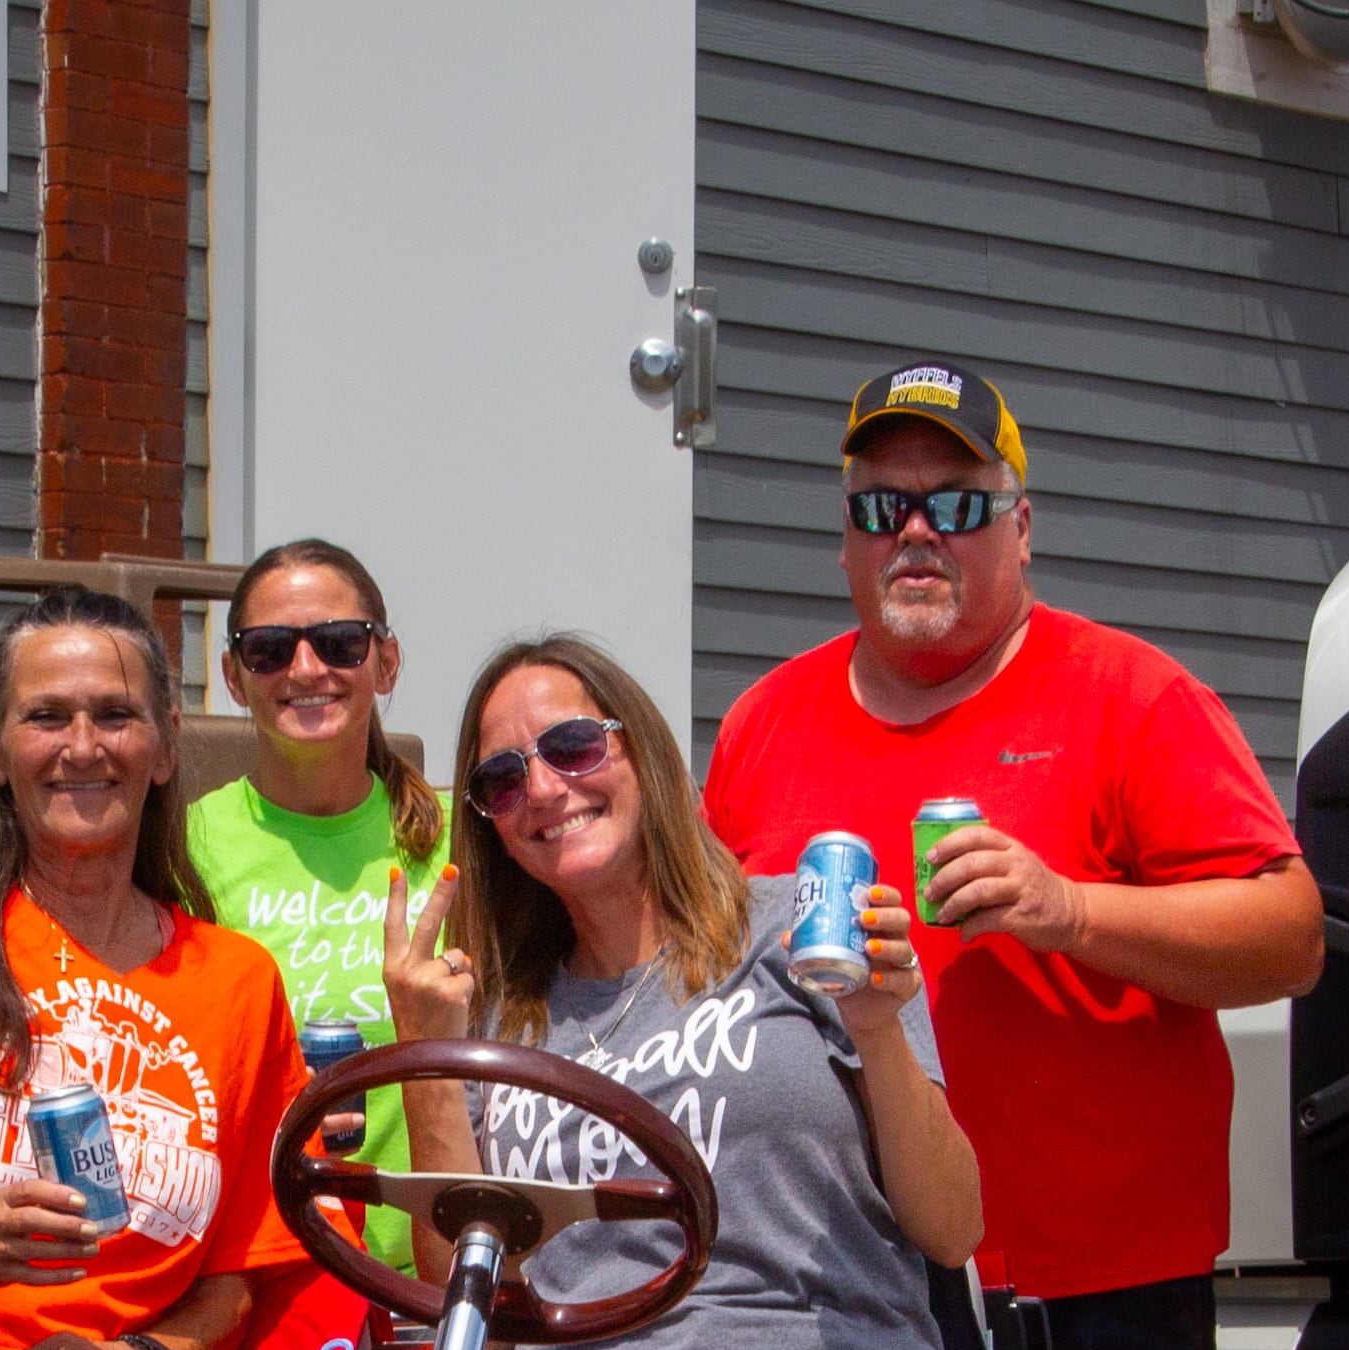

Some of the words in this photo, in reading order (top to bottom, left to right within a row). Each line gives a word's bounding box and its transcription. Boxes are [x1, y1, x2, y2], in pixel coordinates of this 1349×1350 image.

[886, 386, 960, 410] HYBRIDS
[288, 927, 332, 970] to
[338, 930, 383, 971] th
[56, 977, 172, 1032] AGAINST
[168, 1034, 219, 1145] CANCER
[130, 1206, 170, 1233] 017
